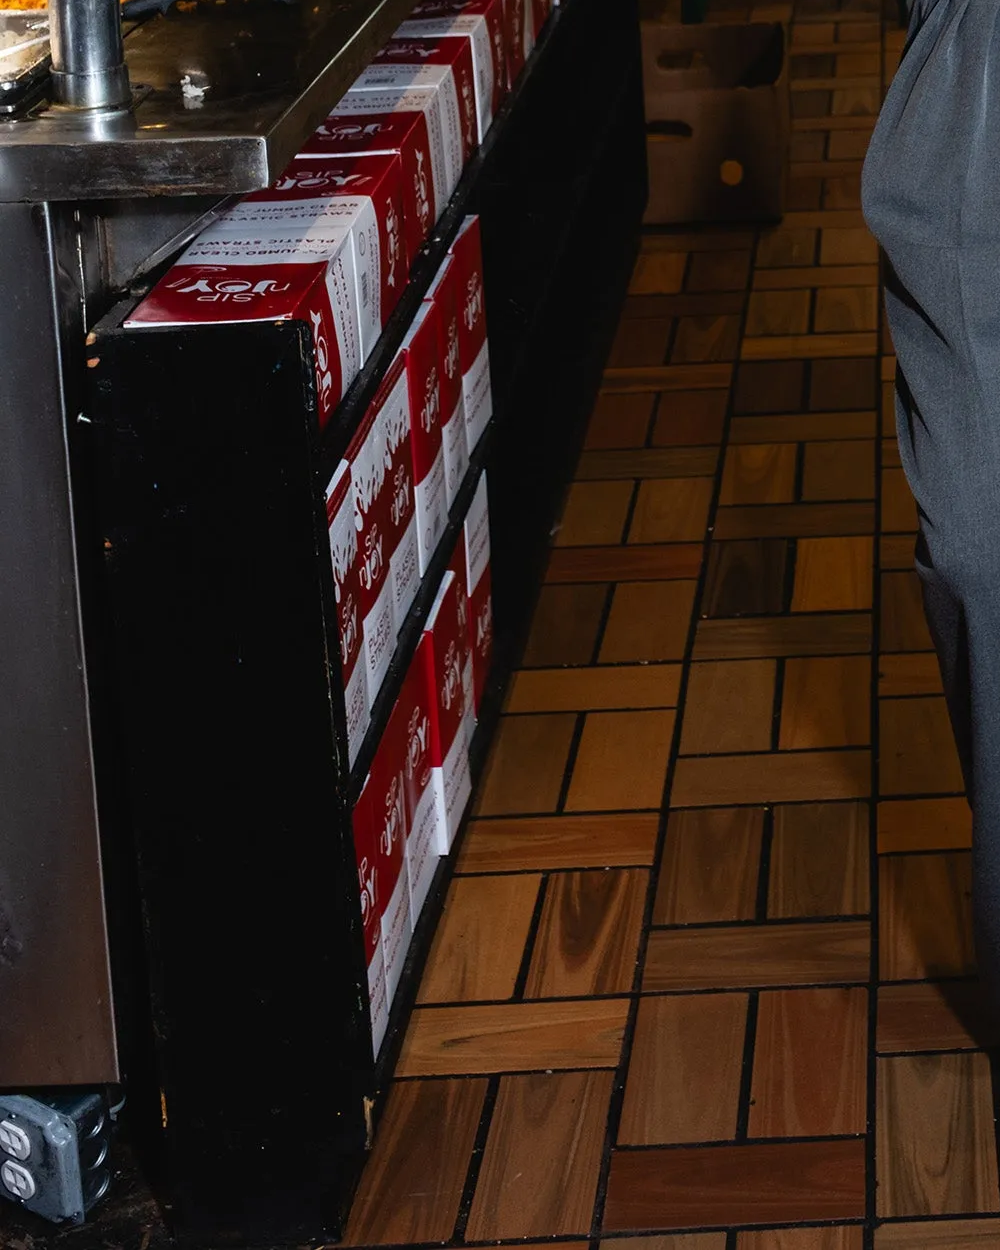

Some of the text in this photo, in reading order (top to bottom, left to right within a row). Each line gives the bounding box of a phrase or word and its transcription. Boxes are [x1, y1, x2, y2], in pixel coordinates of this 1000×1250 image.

[196, 239, 262, 247] STRAWS
[197, 292, 253, 302] SIP
[365, 523, 377, 555] SIP
